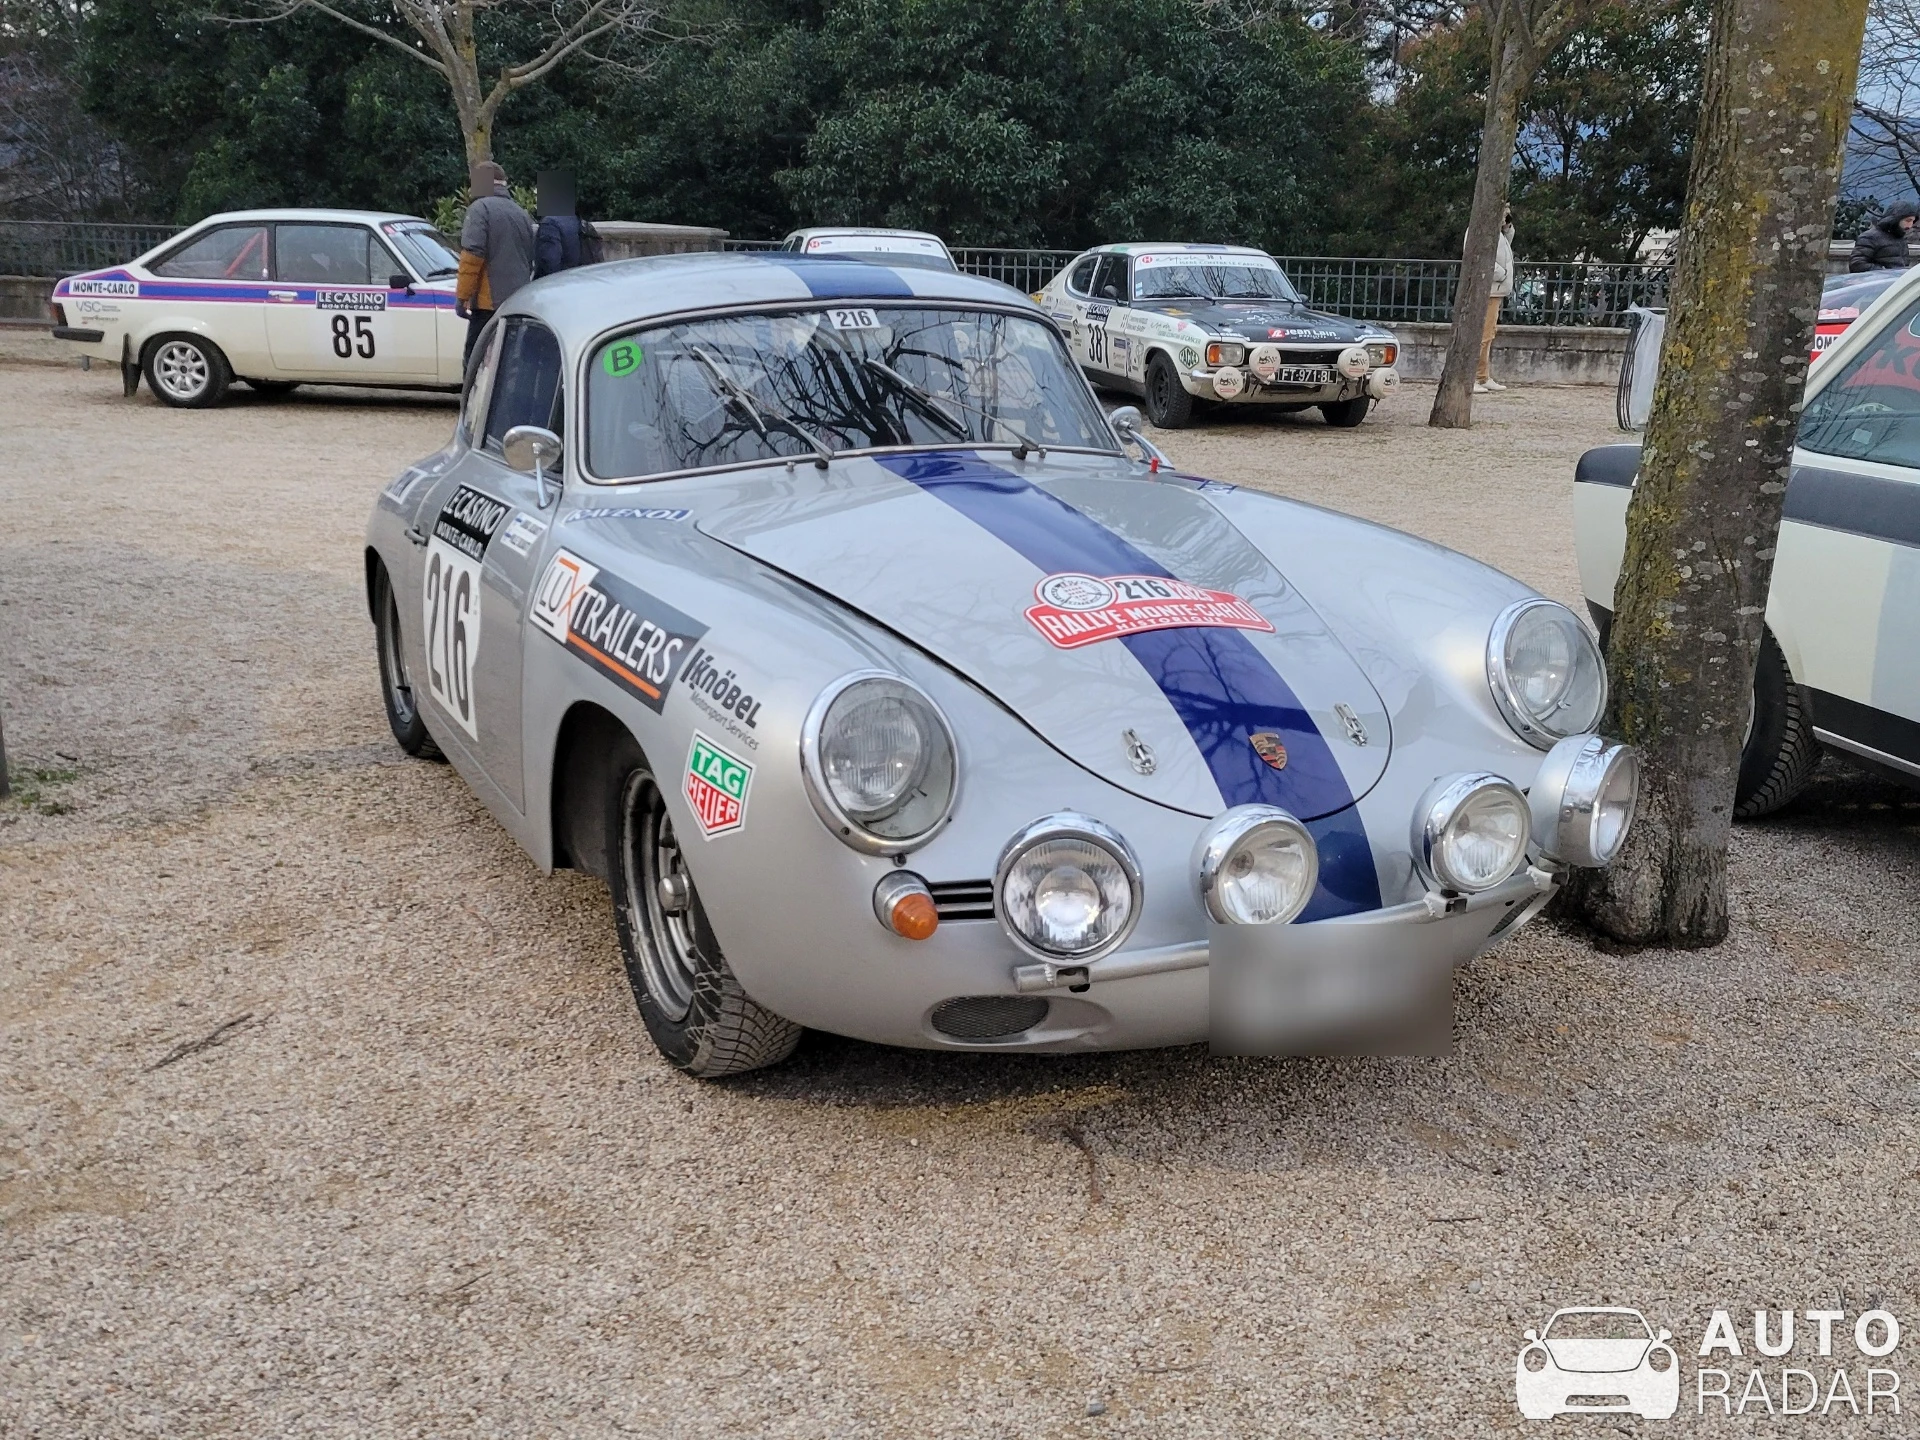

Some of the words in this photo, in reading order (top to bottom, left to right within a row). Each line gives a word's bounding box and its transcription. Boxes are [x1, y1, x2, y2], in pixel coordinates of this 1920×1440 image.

[73, 282, 135, 295] MONTE-CARLO
[319, 292, 332, 302] LE
[333, 292, 384, 304] CASINO
[76, 301, 100, 312] VSC
[321, 303, 380, 311] MONTE-CARLO
[836, 310, 873, 327] 216
[331, 314, 375, 359] 85
[611, 345, 635, 372] B
[442, 487, 467, 515] LE
[453, 492, 506, 535] CASINO
[1115, 580, 1171, 599] 216
[573, 585, 684, 685] TRAILERS
[1038, 609, 1128, 639] RALLYE
[1123, 601, 1262, 622] MONTE-CARLO
[427, 552, 471, 722] 216
[725, 719, 760, 751] Services
[697, 743, 743, 795] TAG
[687, 774, 738, 825] HEUER
